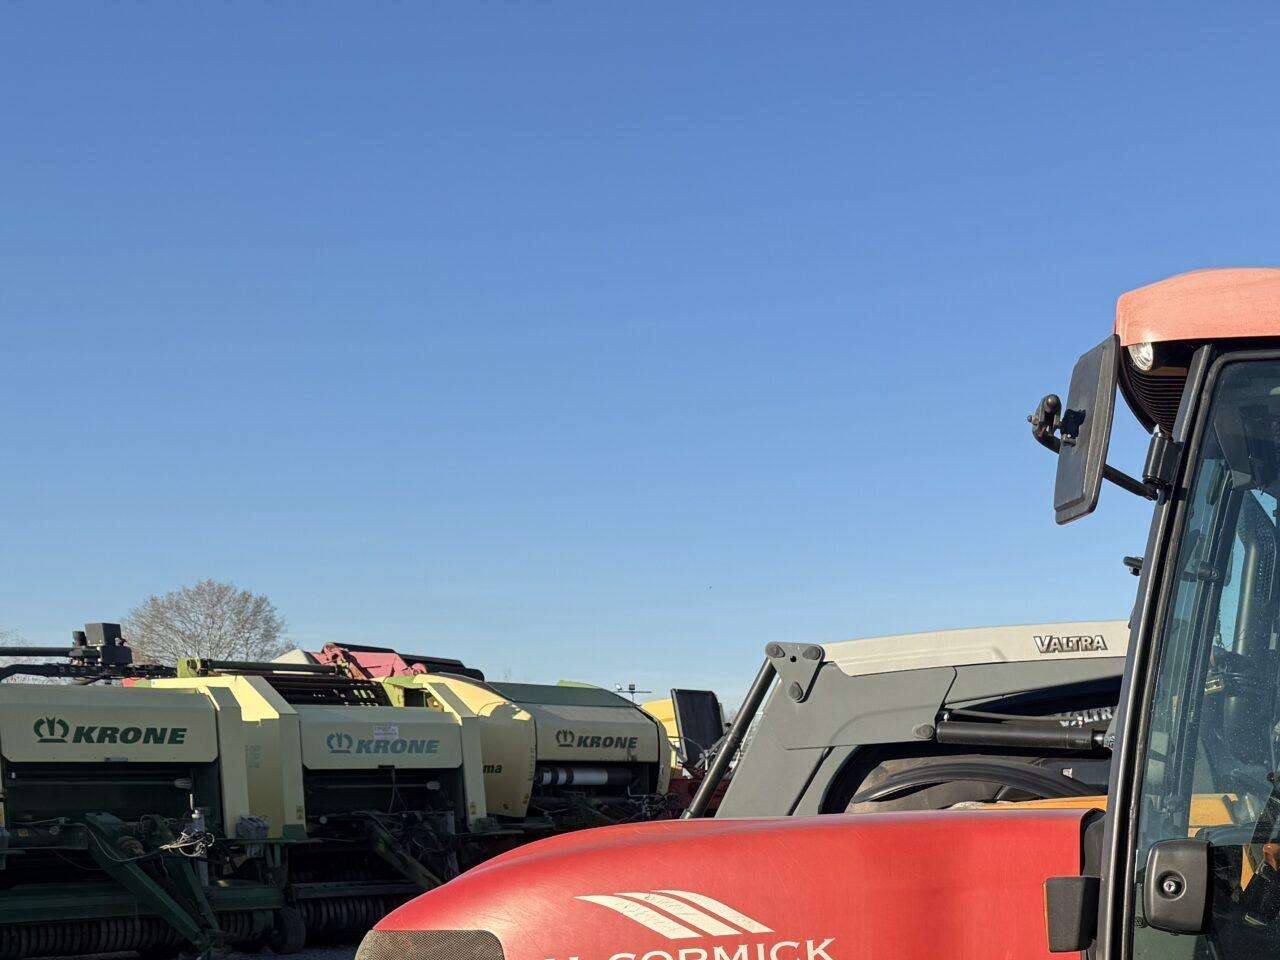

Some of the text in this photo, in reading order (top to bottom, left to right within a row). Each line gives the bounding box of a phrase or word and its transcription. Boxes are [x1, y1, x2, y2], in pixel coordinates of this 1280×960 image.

[1033, 635, 1108, 653] VALTRA
[72, 725, 188, 745] KRONE
[577, 735, 638, 748] KRONE
[355, 736, 440, 754] KRONE
